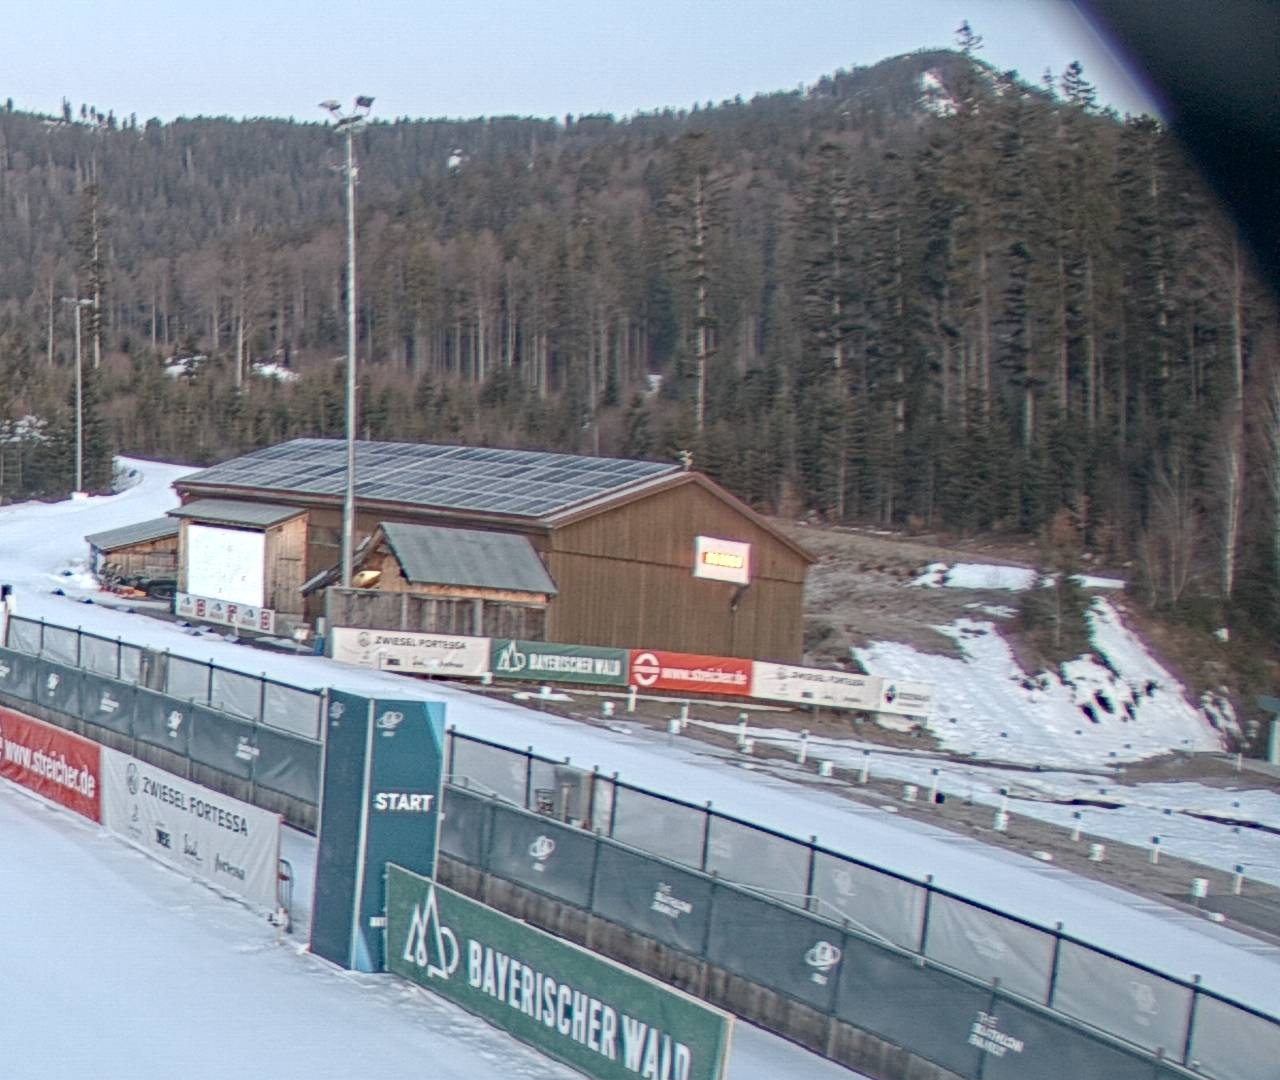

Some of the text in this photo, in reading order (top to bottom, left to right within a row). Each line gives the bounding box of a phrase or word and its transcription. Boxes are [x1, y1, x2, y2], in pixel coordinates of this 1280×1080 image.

[4, 738, 96, 799] www.streicher.de
[142, 776, 249, 837] ZWIESEL FORTESSA
[375, 792, 435, 813] START
[466, 939, 618, 1062] BAYERISCHER
